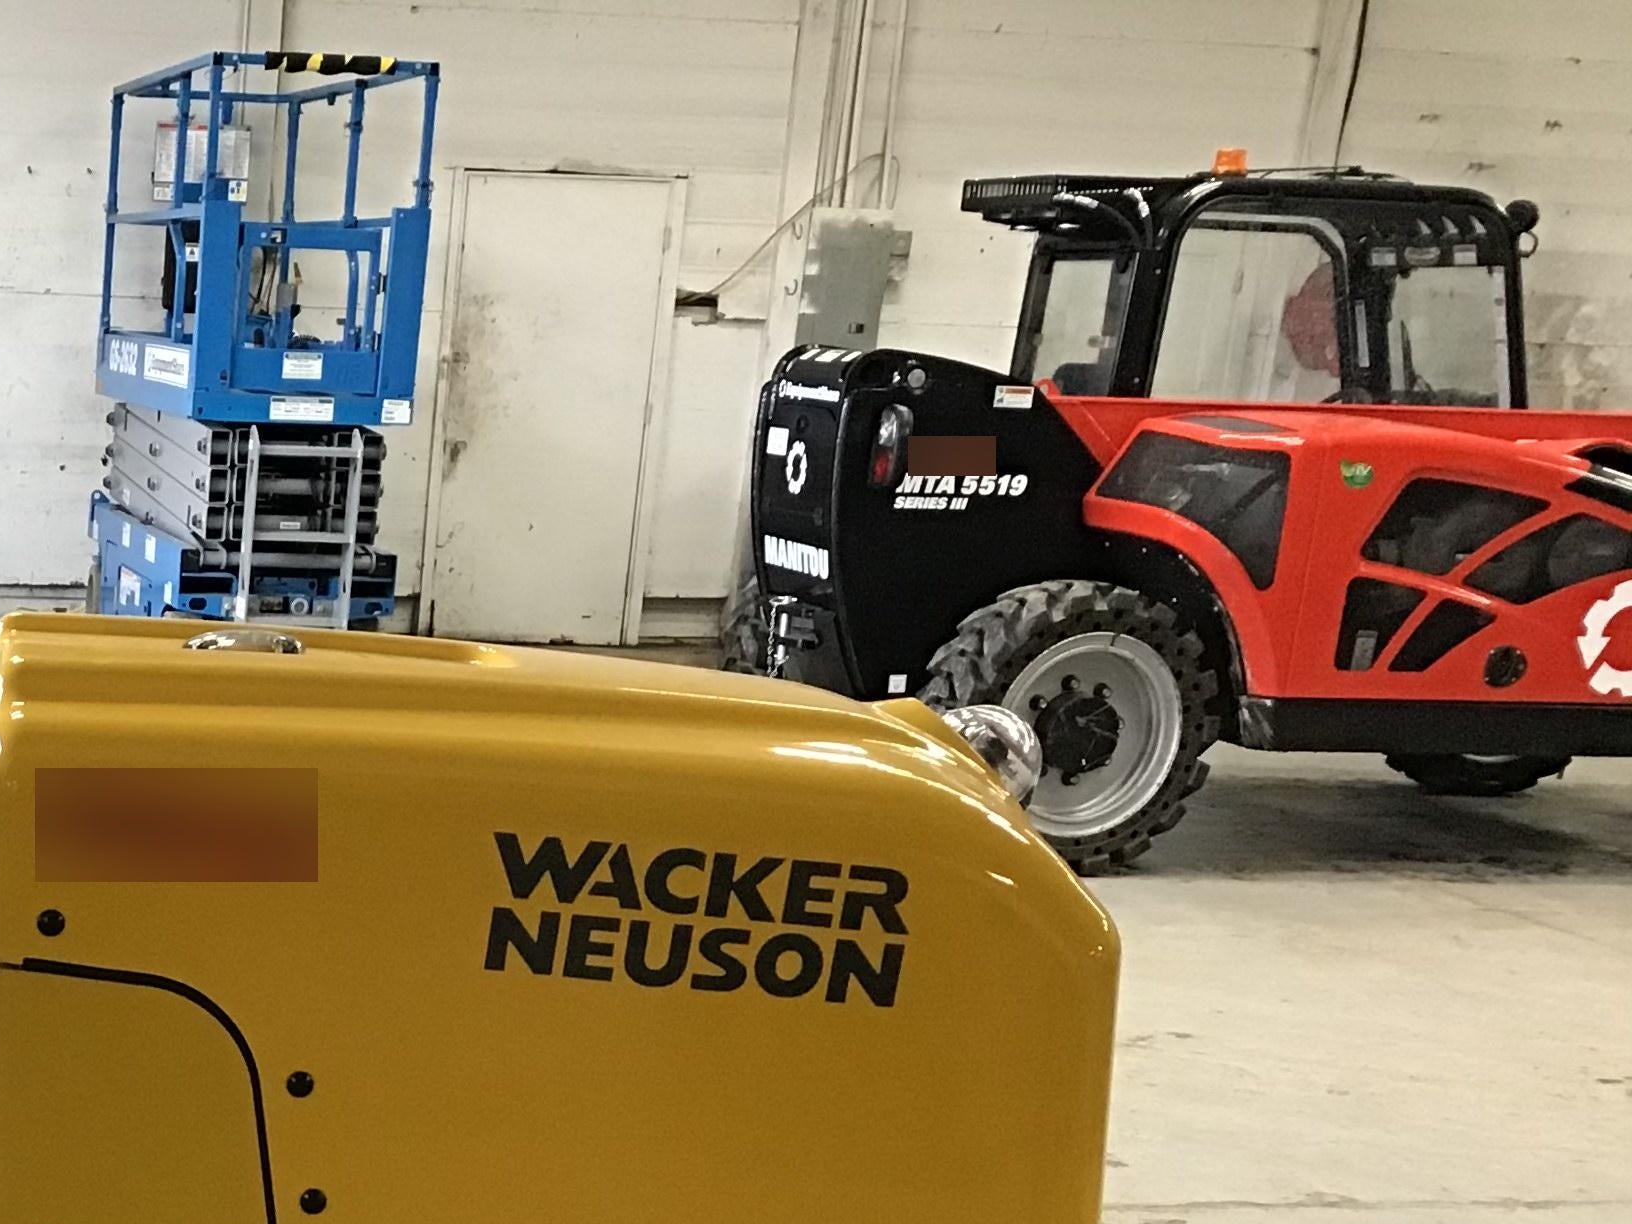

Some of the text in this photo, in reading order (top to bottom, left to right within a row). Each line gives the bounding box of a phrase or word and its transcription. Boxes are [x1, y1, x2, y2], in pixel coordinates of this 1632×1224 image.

[893, 496, 968, 509] SERIES III
[895, 473, 1028, 496] MTA 5519
[764, 535, 829, 579] MANITOU
[493, 832, 909, 935] WACKER
[484, 906, 906, 1007] NEUSON
